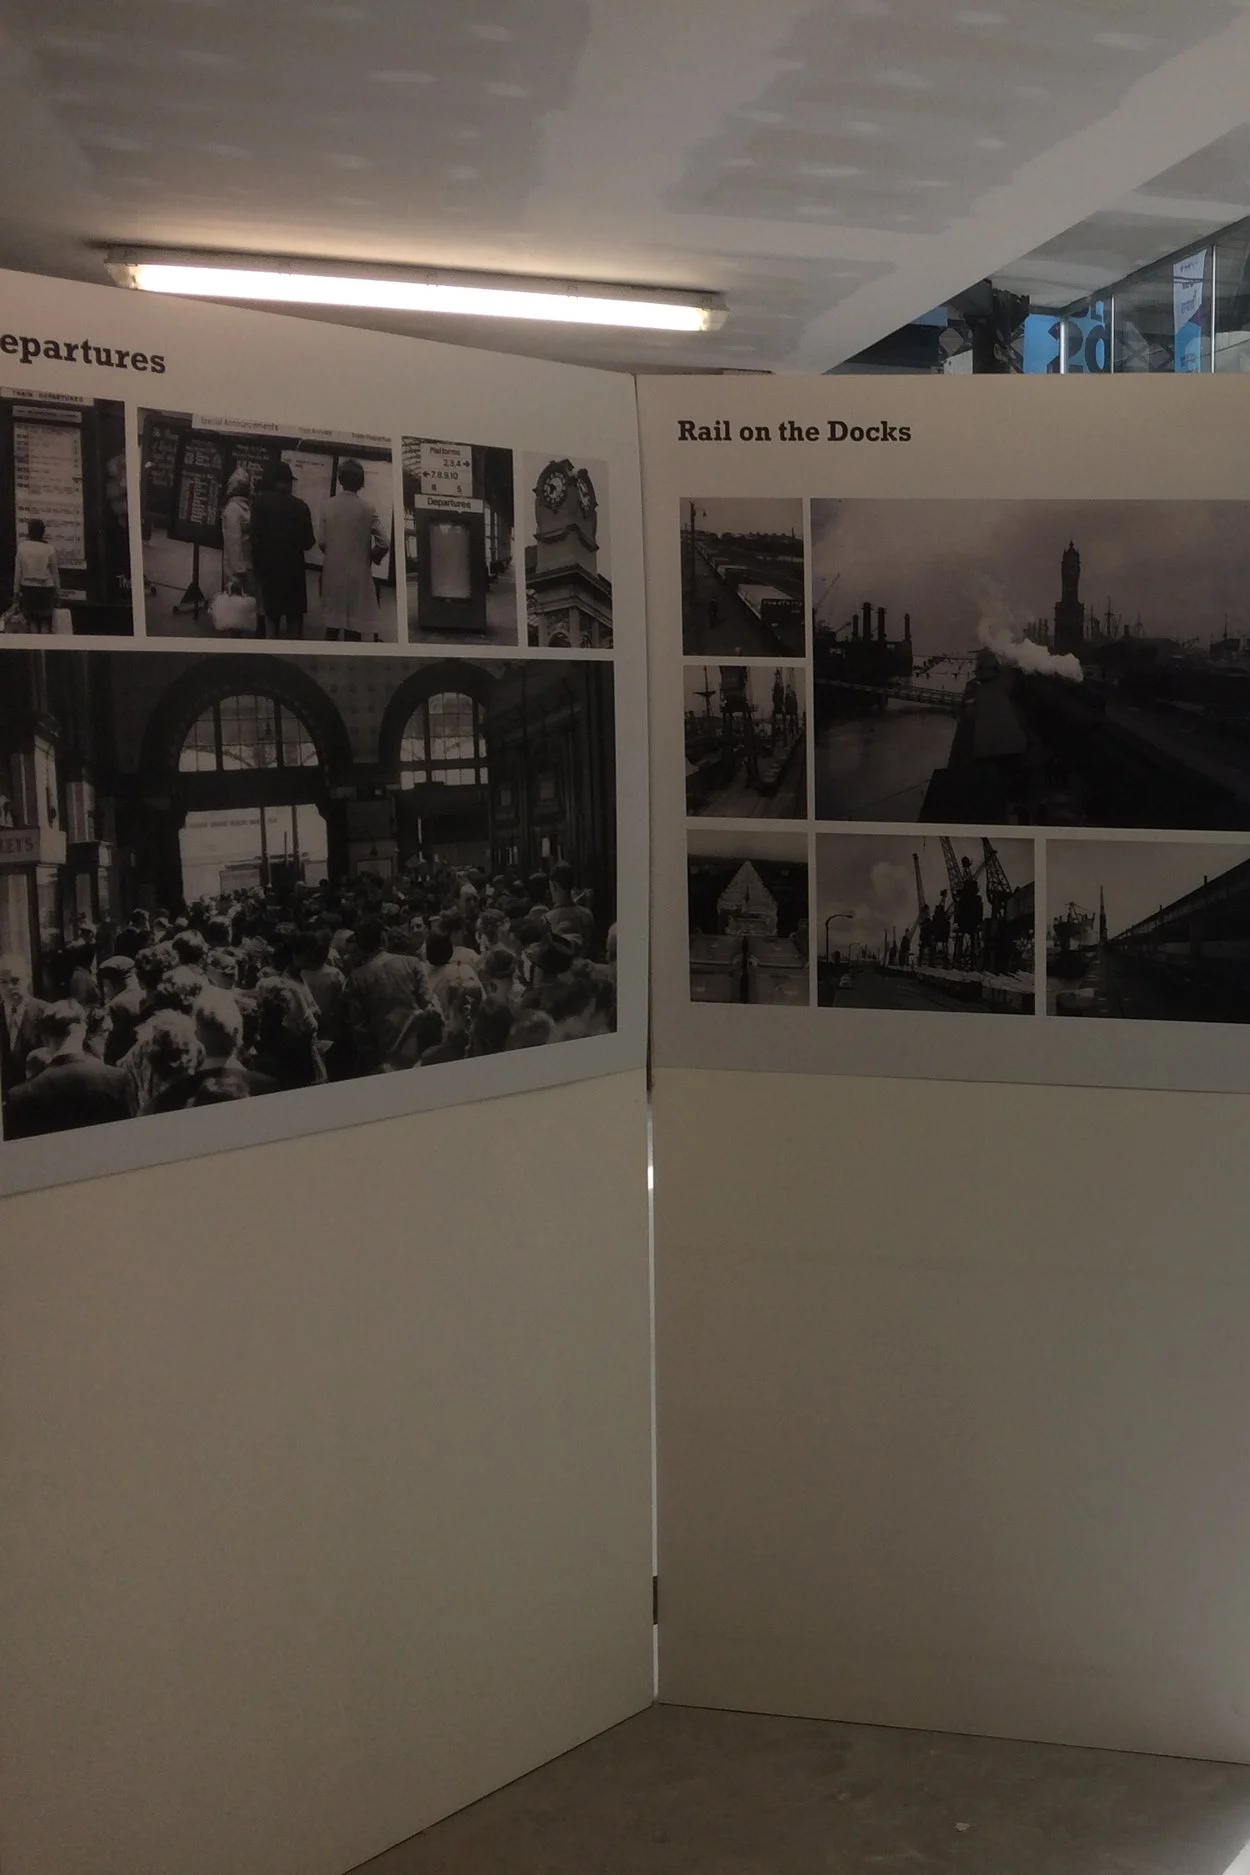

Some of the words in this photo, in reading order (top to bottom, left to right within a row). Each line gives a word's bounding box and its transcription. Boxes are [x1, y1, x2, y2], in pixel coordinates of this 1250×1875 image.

[677, 420, 732, 442] Rail
[739, 425, 772, 442] on
[778, 420, 820, 442] the
[827, 420, 911, 442] Docks
[430, 446, 461, 456] Platforms
[456, 485, 463, 494] 5
[427, 497, 472, 509] Departures
